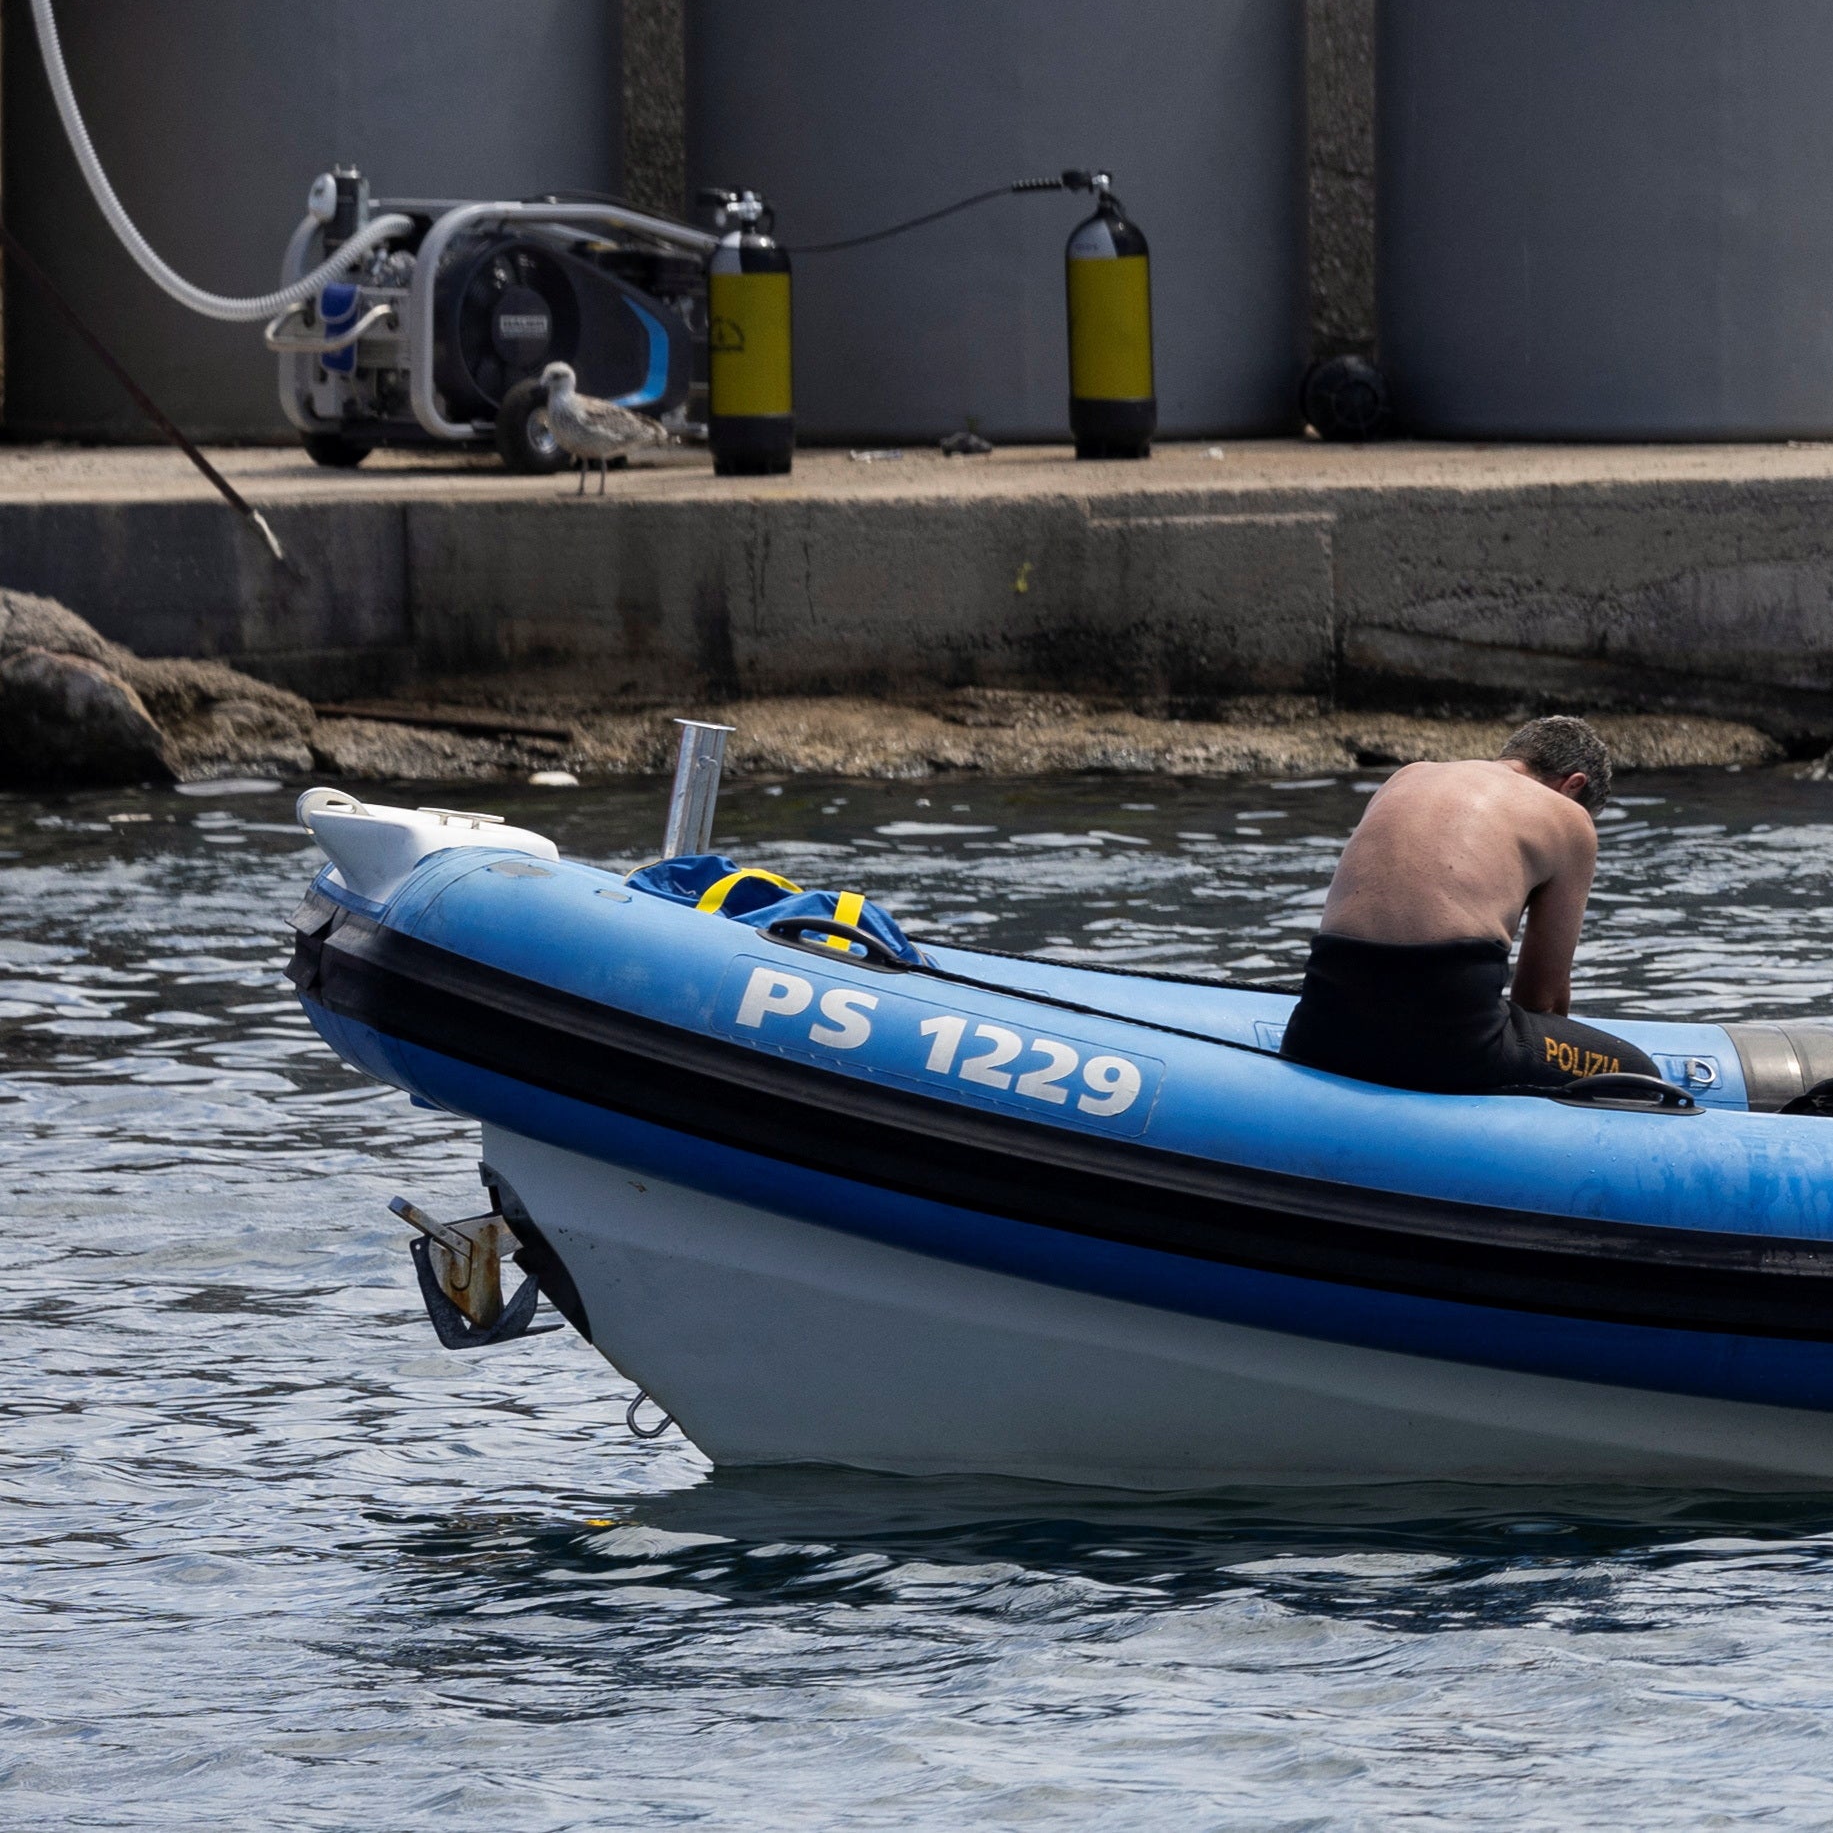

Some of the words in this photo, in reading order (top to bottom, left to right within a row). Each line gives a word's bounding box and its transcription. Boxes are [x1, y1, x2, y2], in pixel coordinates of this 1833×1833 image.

[734, 966, 880, 1050] PS
[919, 1014, 1143, 1118] 1229
[1544, 1037, 1620, 1078] POLIZIA
